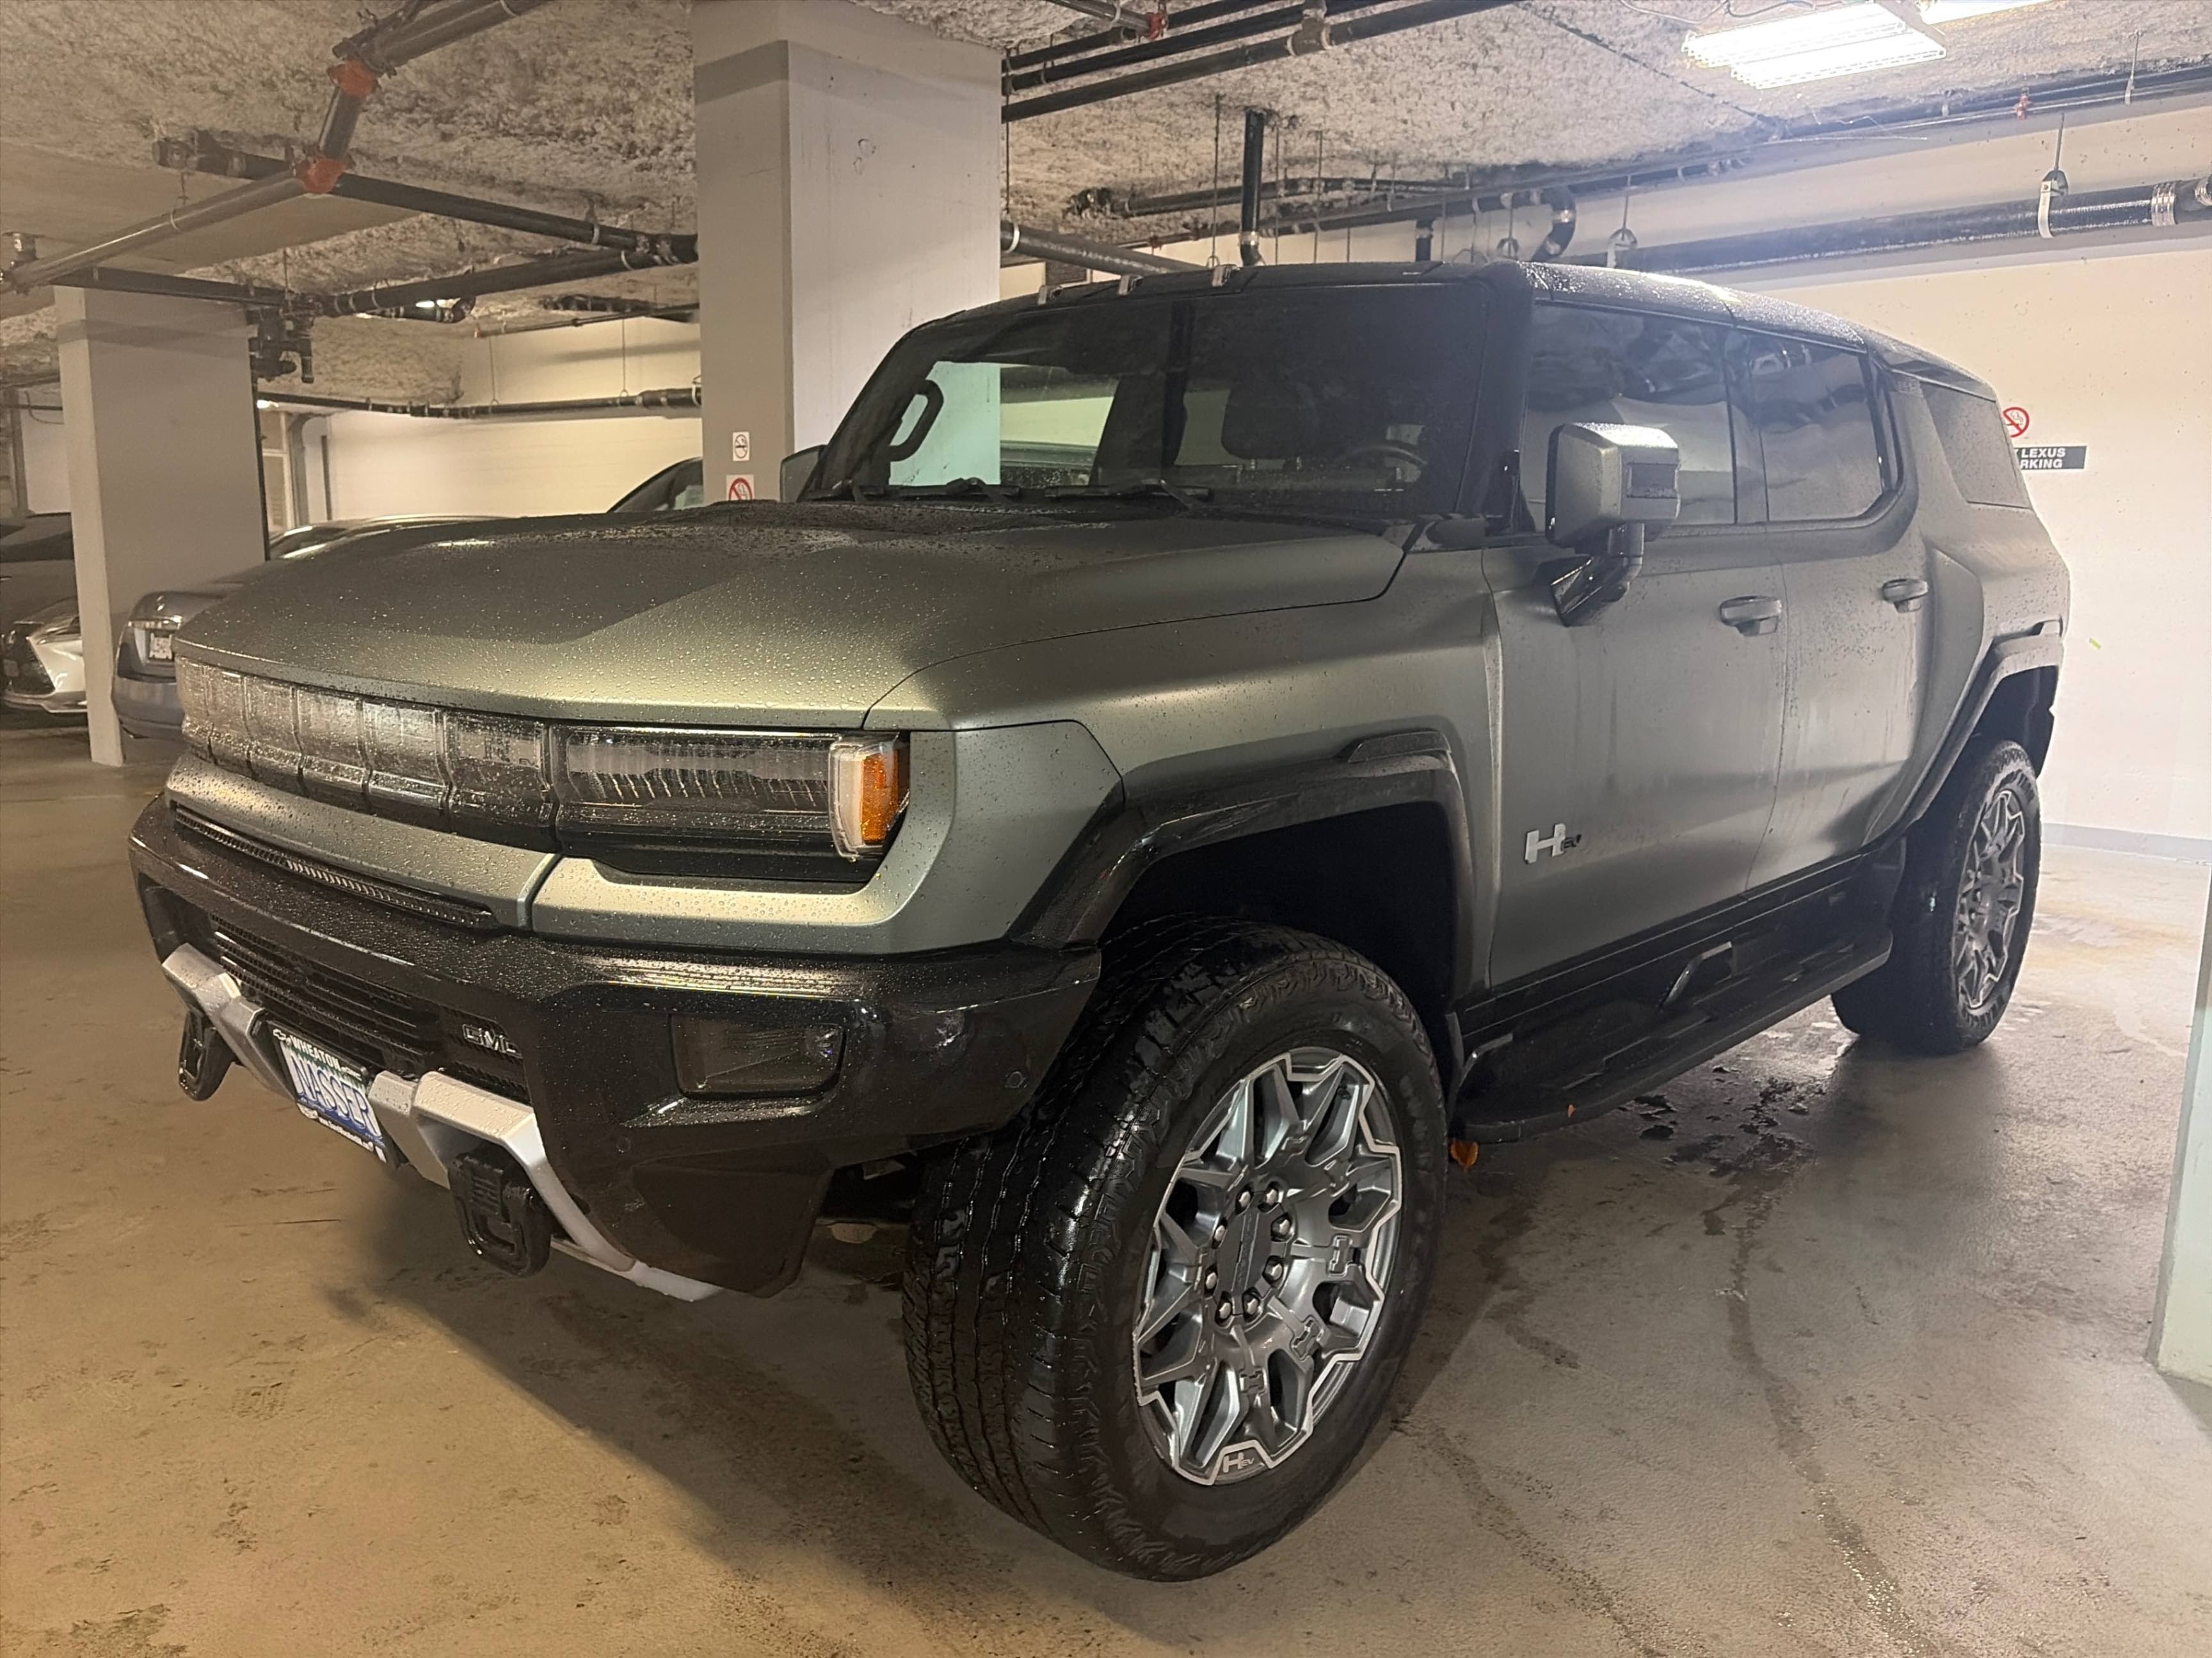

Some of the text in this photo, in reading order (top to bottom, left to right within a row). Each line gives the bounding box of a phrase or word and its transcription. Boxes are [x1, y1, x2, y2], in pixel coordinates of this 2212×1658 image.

[2020, 459, 2063, 469] RKING
[2021, 448, 2065, 458] LEXUS
[289, 1035, 341, 1071] WHEATON
[462, 1024, 523, 1058] GMC
[291, 1055, 378, 1136] NASSER
